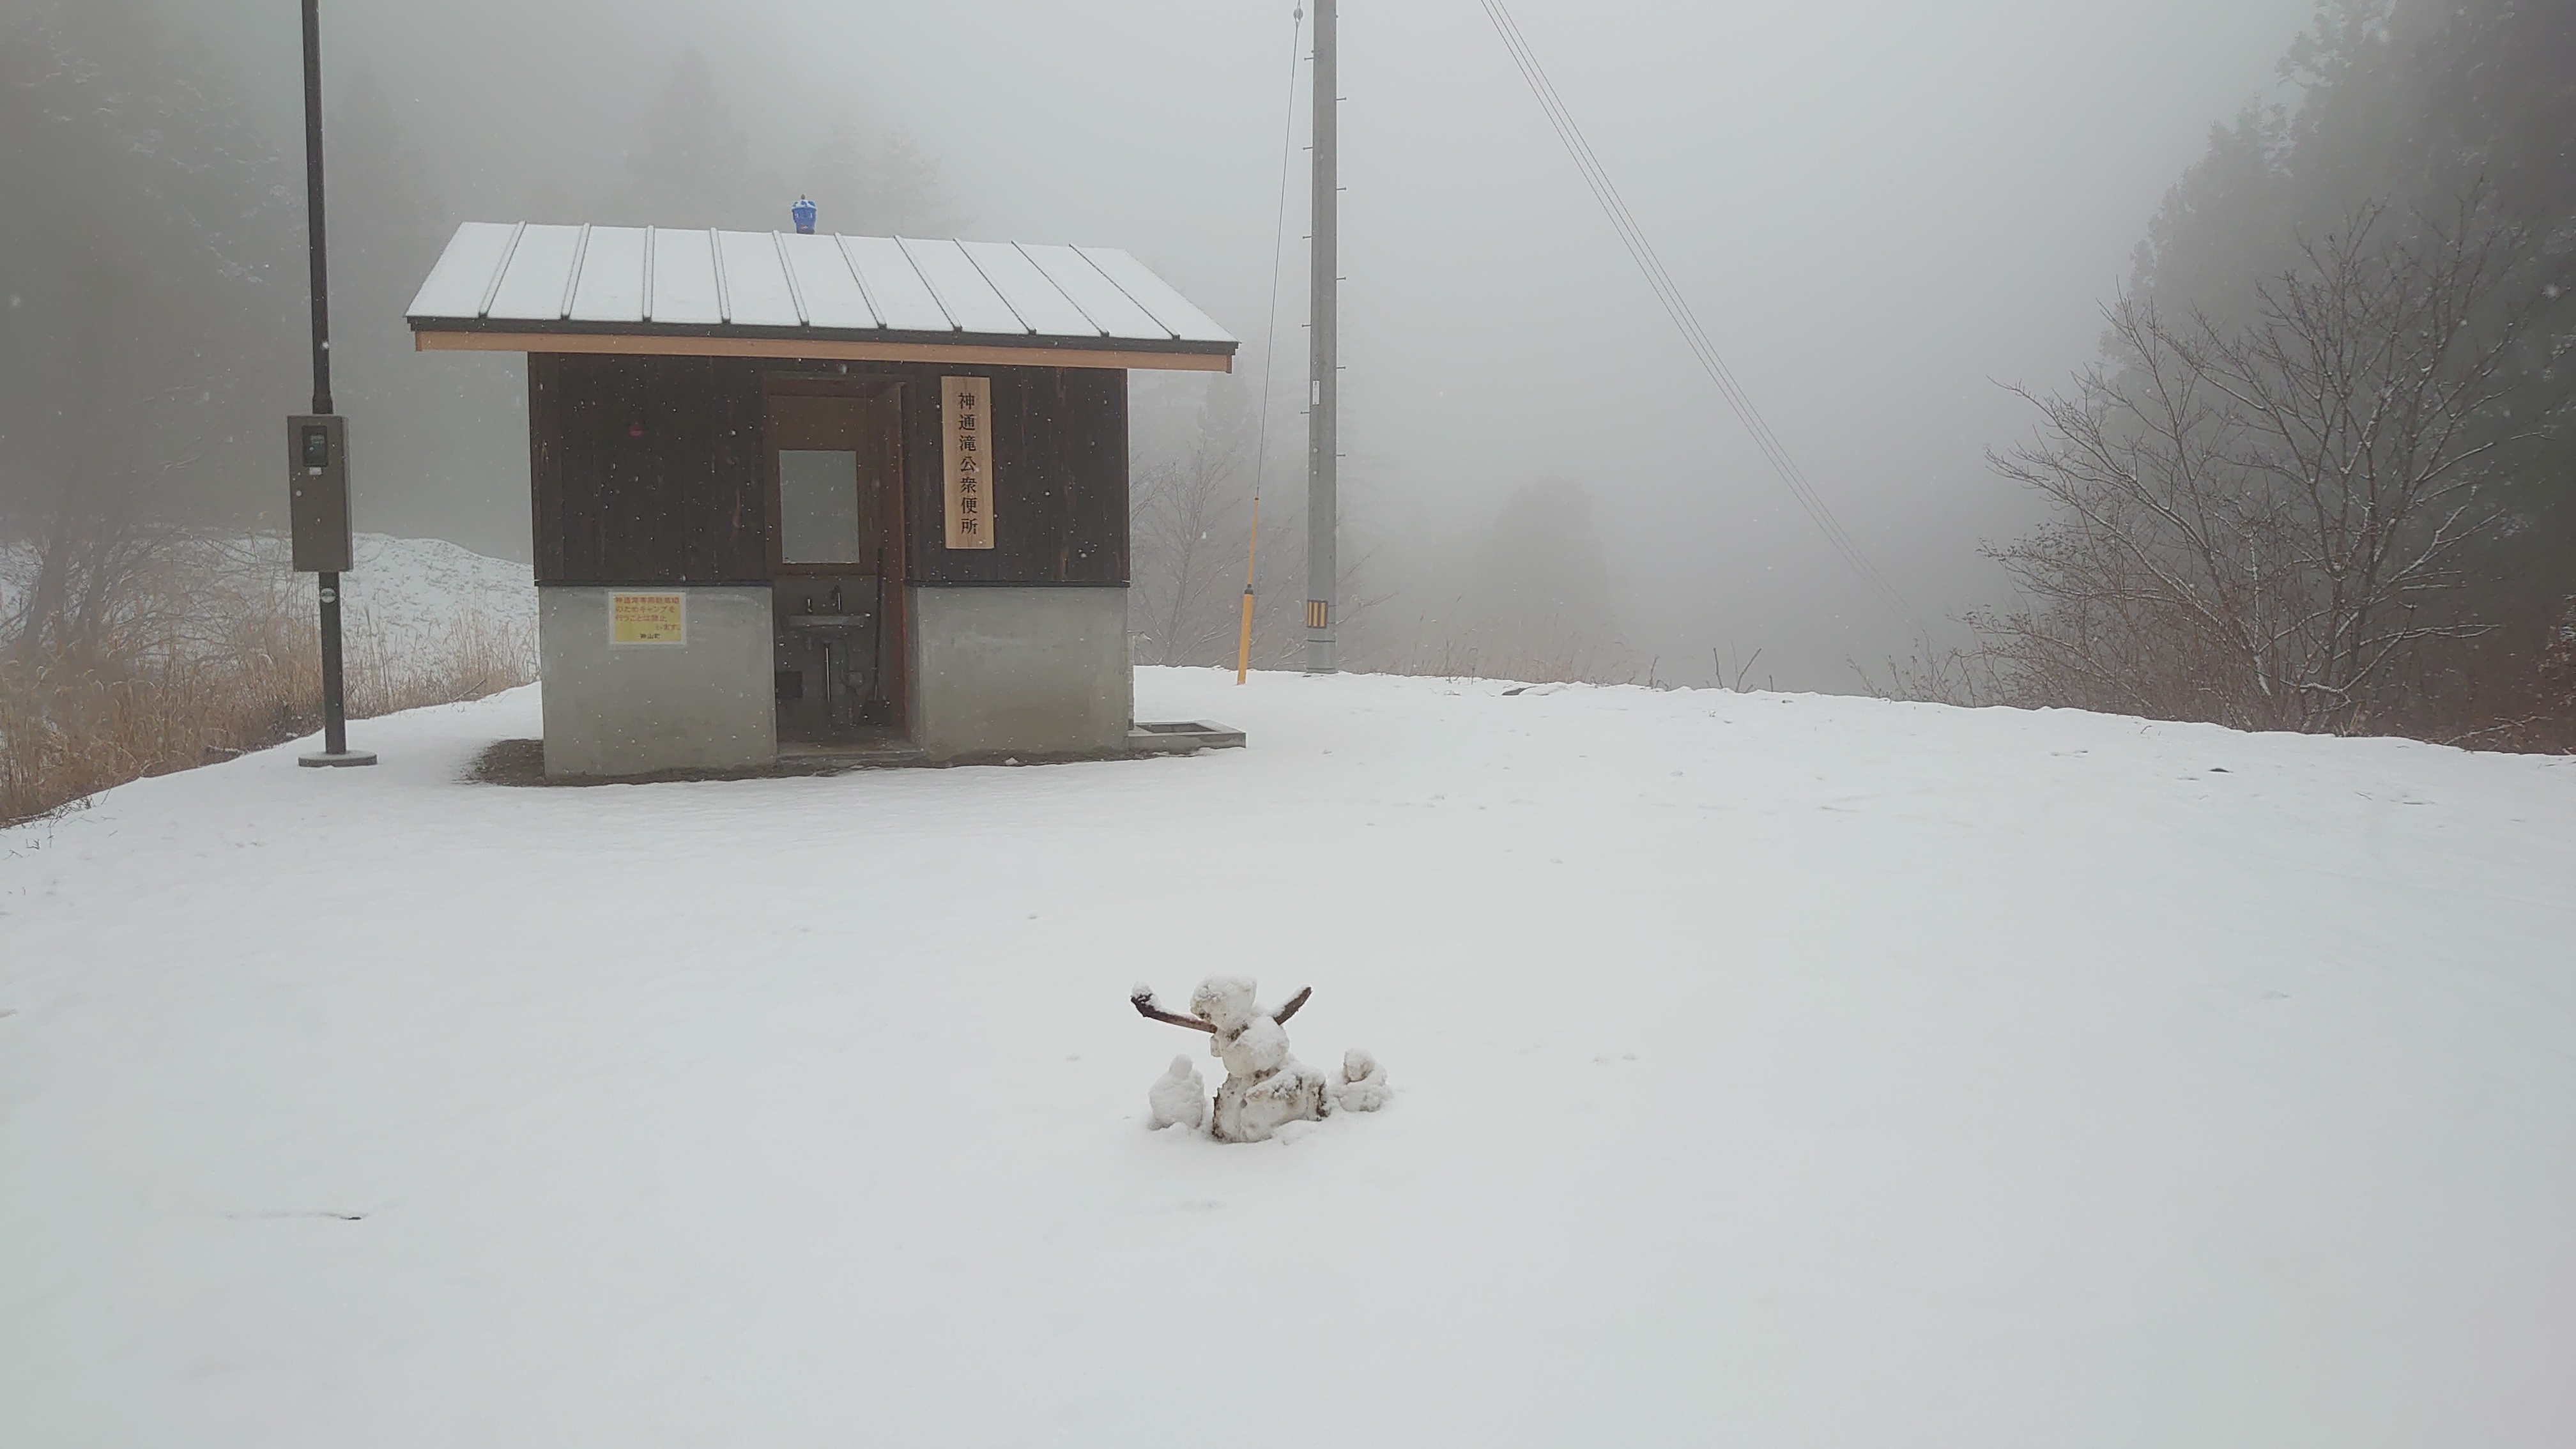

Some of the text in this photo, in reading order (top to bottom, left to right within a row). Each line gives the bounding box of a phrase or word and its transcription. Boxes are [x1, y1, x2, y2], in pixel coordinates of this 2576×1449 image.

[958, 392, 978, 535] 神通滝公衆便所
